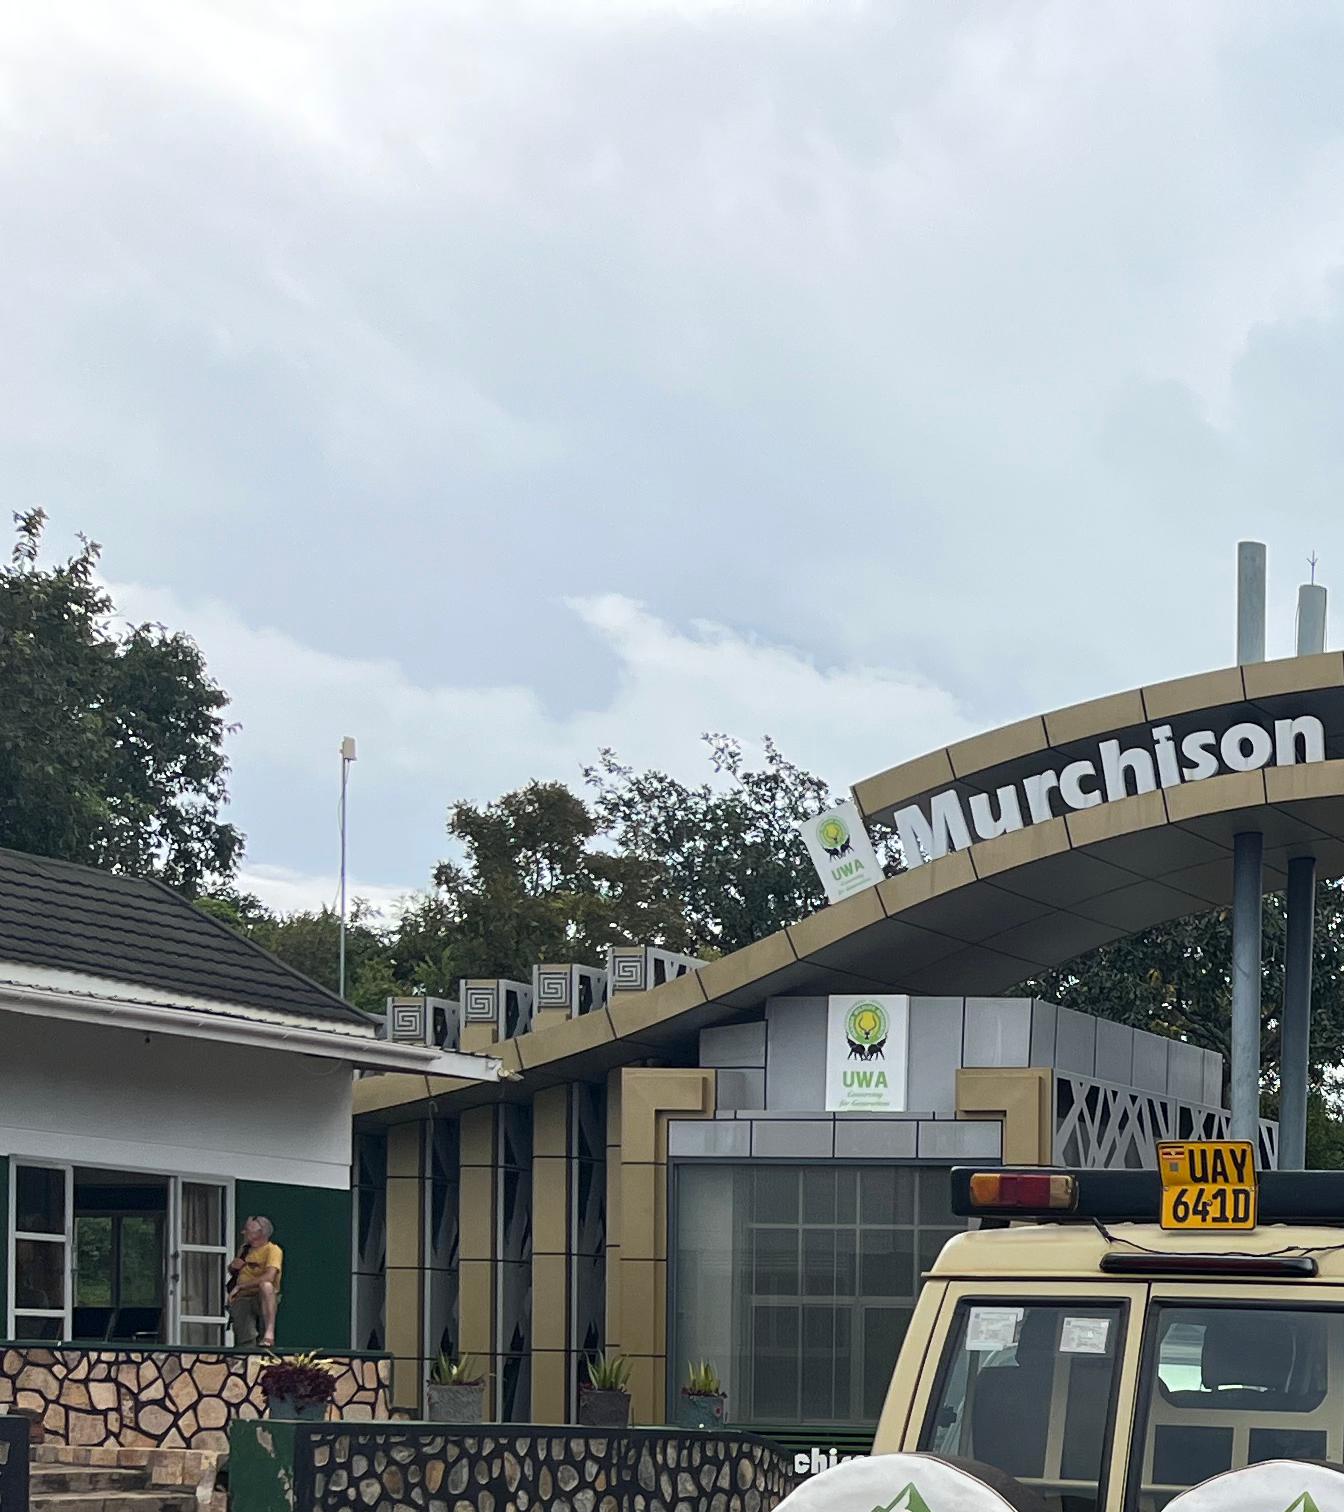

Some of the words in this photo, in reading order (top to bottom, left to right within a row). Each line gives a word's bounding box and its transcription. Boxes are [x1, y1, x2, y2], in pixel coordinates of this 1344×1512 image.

[894, 714, 1326, 870] Murchison
[831, 859, 865, 880] UWA
[842, 1071, 888, 1088] UWA
[1188, 1148, 1248, 1184] UAY
[1172, 1188, 1251, 1223] 641D
